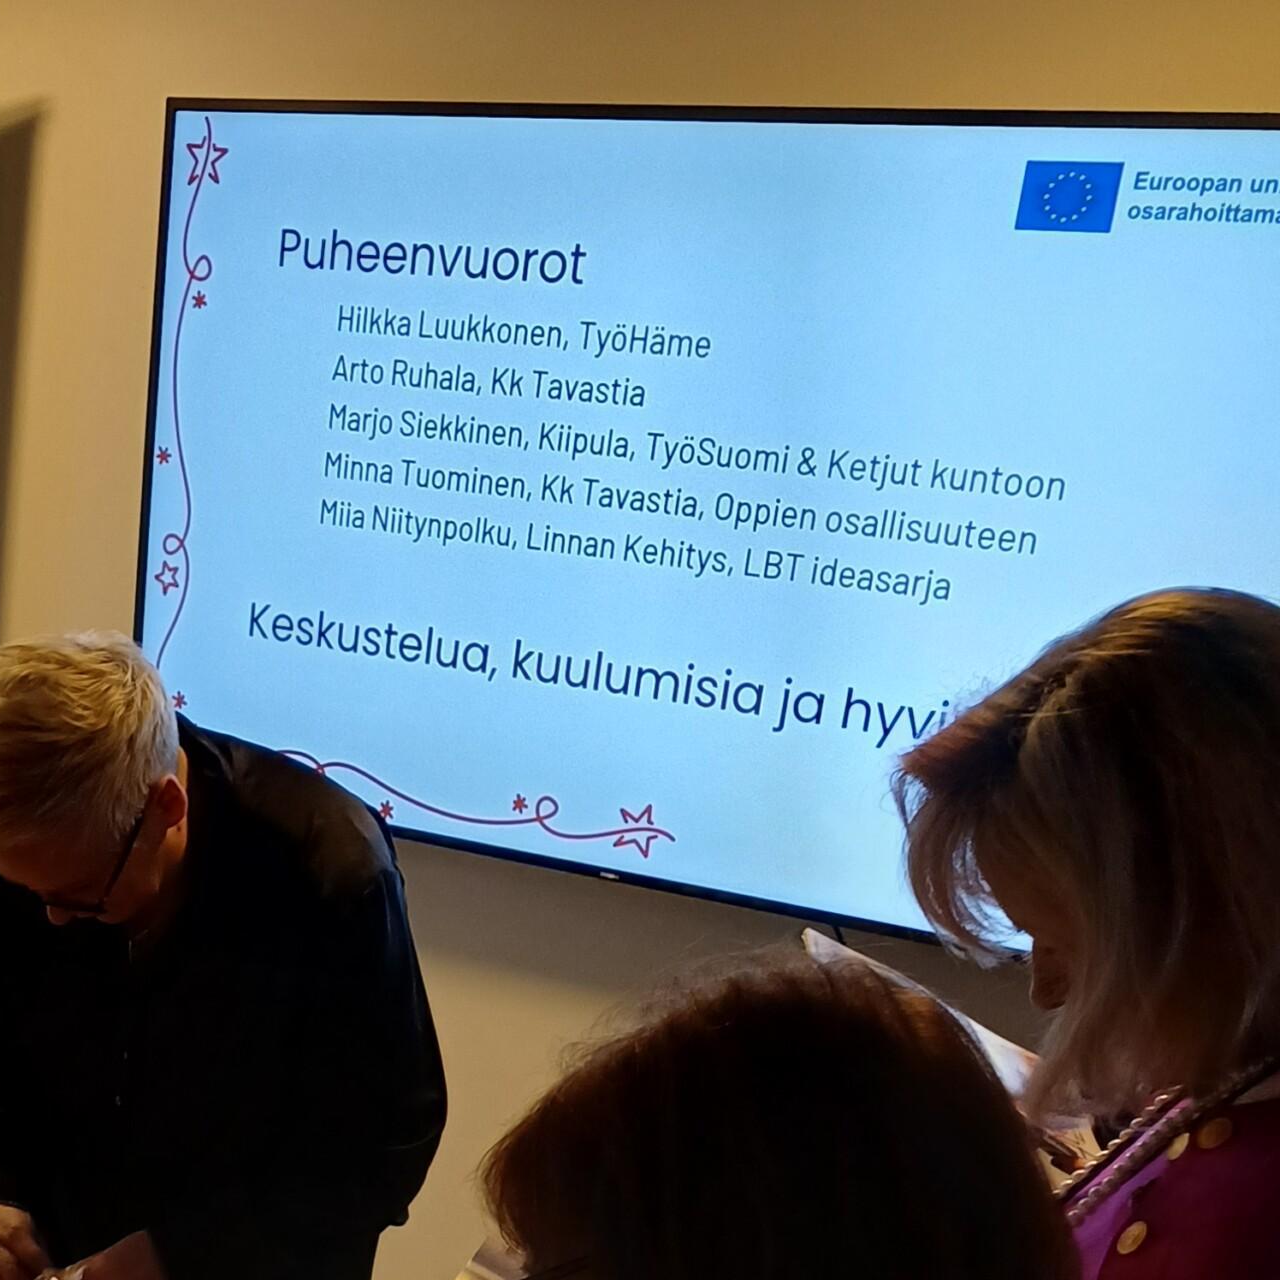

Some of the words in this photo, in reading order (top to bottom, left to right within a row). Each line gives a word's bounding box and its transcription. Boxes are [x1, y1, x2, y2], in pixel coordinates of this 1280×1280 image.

[1133, 171, 1243, 197] Euroopan
[1250, 178, 1280, 194] un
[278, 228, 588, 285] Puheenvuorot
[337, 304, 412, 337] Hilkka
[419, 310, 570, 352] Luukkonen,
[579, 320, 712, 359] TyöHäme
[331, 355, 385, 385] Arto
[391, 359, 483, 397] Ruhala,
[490, 368, 524, 397] Kk
[531, 370, 646, 408] Tavastia
[327, 402, 394, 440] Marjo
[399, 410, 531, 452] Siekkinen,
[537, 423, 637, 463] Kiipula,
[646, 432, 791, 476] TyöSuomi
[796, 447, 818, 477] &
[826, 449, 923, 492] Ketjut
[930, 458, 1067, 502] kuntoon
[323, 452, 394, 485] Minna
[402, 459, 533, 503] Tuominen,
[540, 474, 575, 504] Kk
[583, 478, 706, 523] Tavastia,
[714, 493, 817, 532] Oppien
[825, 507, 1039, 557] osallisuuteen
[319, 498, 366, 530] Miia
[371, 505, 518, 551] Niitynpolku,
[525, 522, 616, 560] Linnan
[622, 534, 736, 580] Kehitys,
[743, 548, 806, 584] LBT
[811, 555, 953, 606] ideasarja
[248, 601, 499, 684] Keskustelua,
[512, 639, 765, 716] kuulumisia
[773, 677, 826, 733] ja
